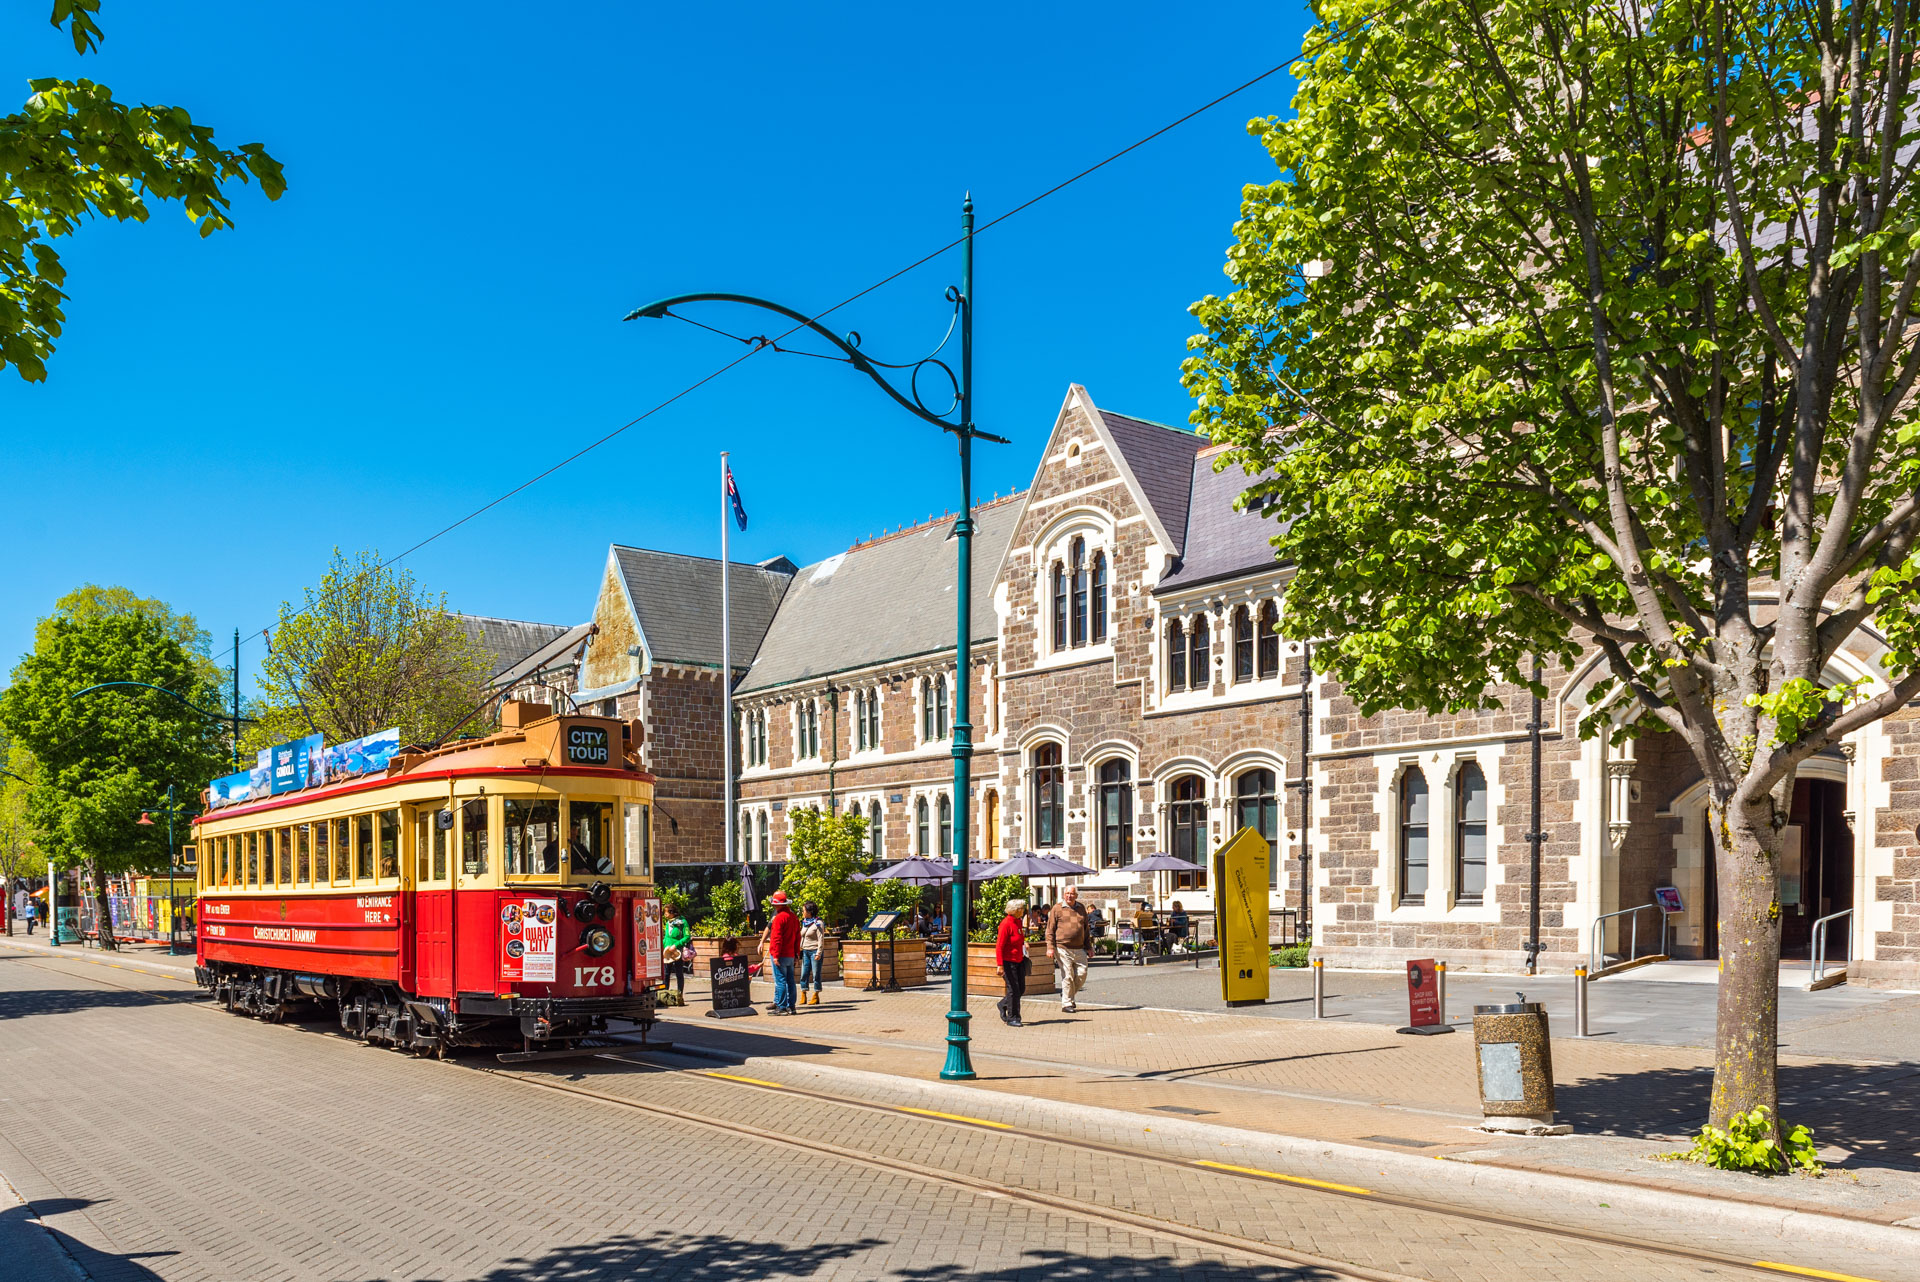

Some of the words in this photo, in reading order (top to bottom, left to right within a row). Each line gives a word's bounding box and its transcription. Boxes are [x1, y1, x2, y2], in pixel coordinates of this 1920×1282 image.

[571, 731, 603, 744] CITY
[568, 747, 607, 760] TOUR
[276, 764, 295, 778] GONDOLA
[357, 897, 364, 908] NO
[365, 896, 392, 908] ENTRANCE
[1235, 869, 1243, 889] Clock
[1241, 889, 1249, 909] Tower
[1247, 909, 1258, 939] Entrance
[365, 911, 381, 923] HERE
[253, 926, 291, 941] CHRISTCHURCH
[291, 928, 317, 943] TRAMWAY
[525, 926, 554, 941] QUAKE
[529, 940, 549, 952] CITY
[573, 966, 615, 987] 178
